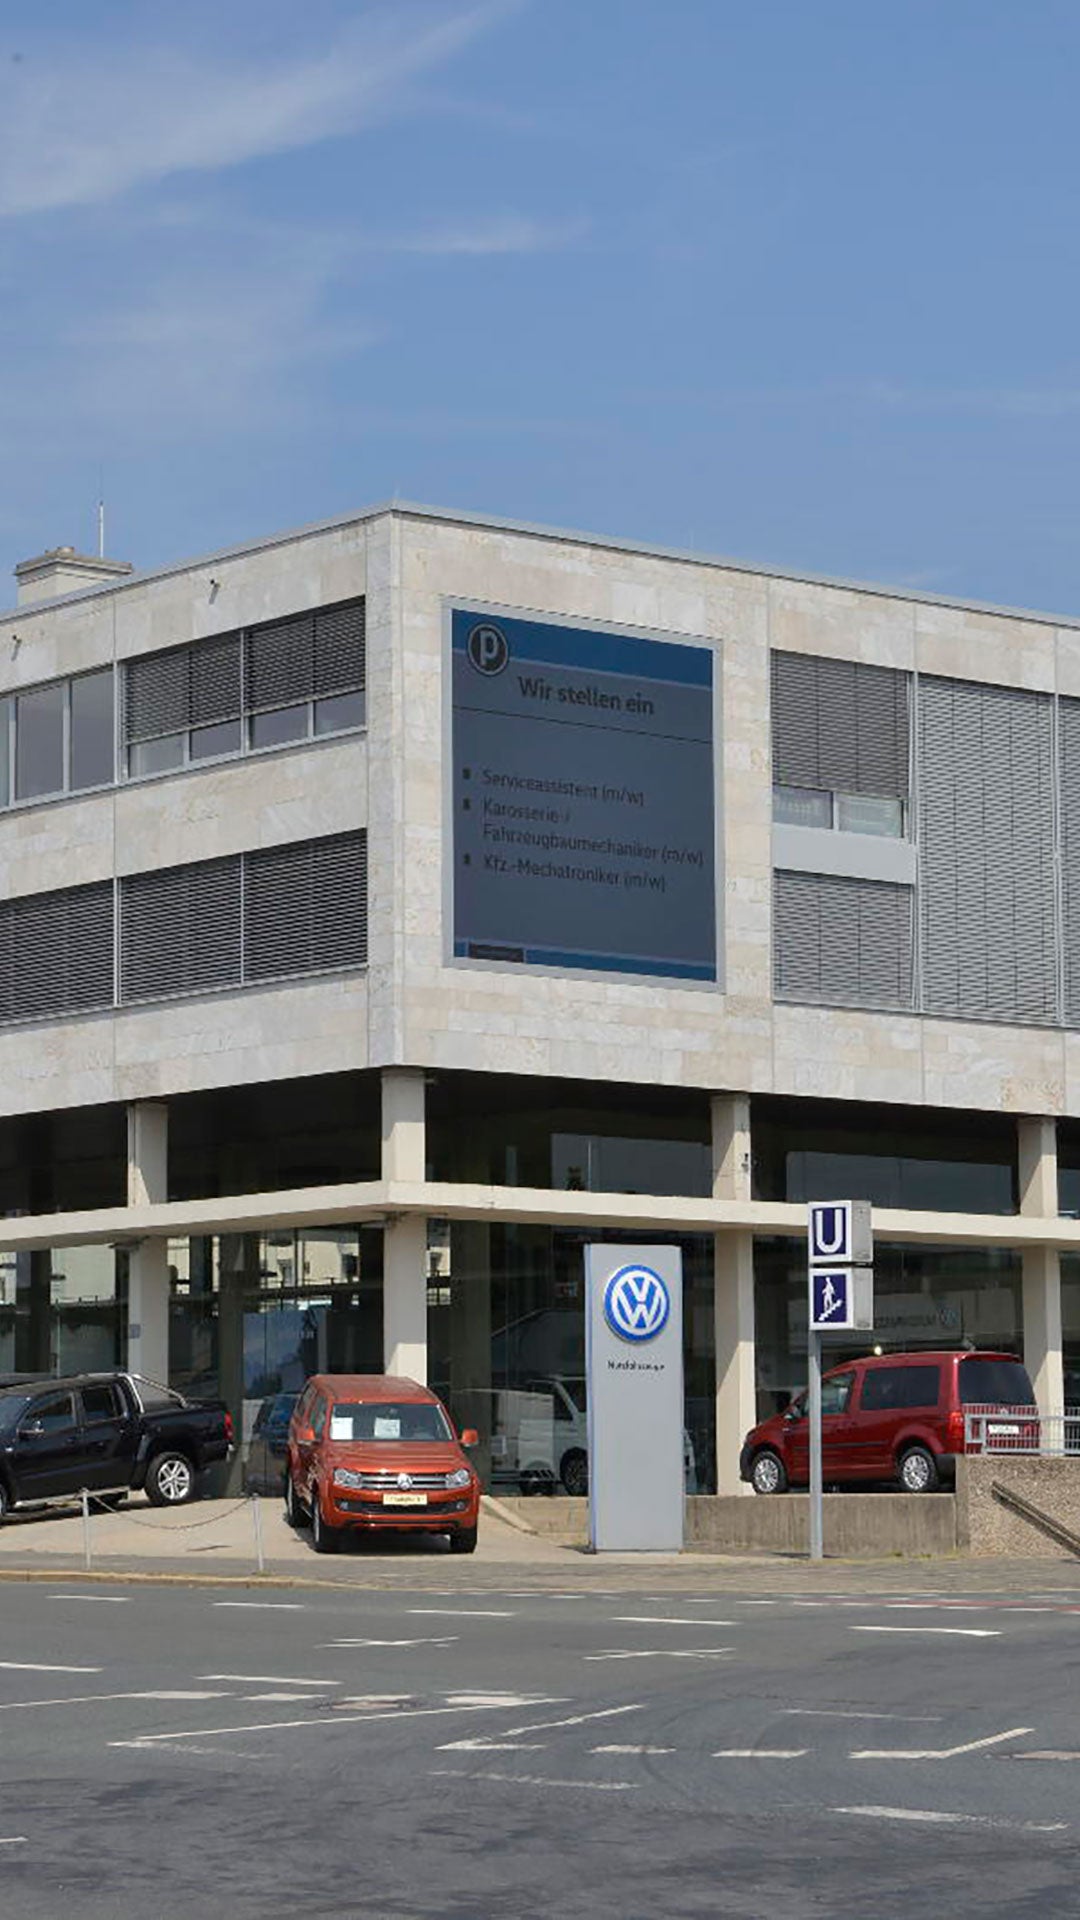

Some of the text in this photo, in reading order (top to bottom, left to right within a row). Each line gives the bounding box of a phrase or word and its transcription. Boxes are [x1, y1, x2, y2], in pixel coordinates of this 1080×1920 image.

[517, 676, 655, 715] Wir stellen ein
[483, 769, 645, 807] Serviceassistent (m/w)
[483, 823, 704, 868] Fahrzeugbaumechaniker (m/w)
[624, 871, 666, 893] (m/w)
[815, 1209, 844, 1254] U
